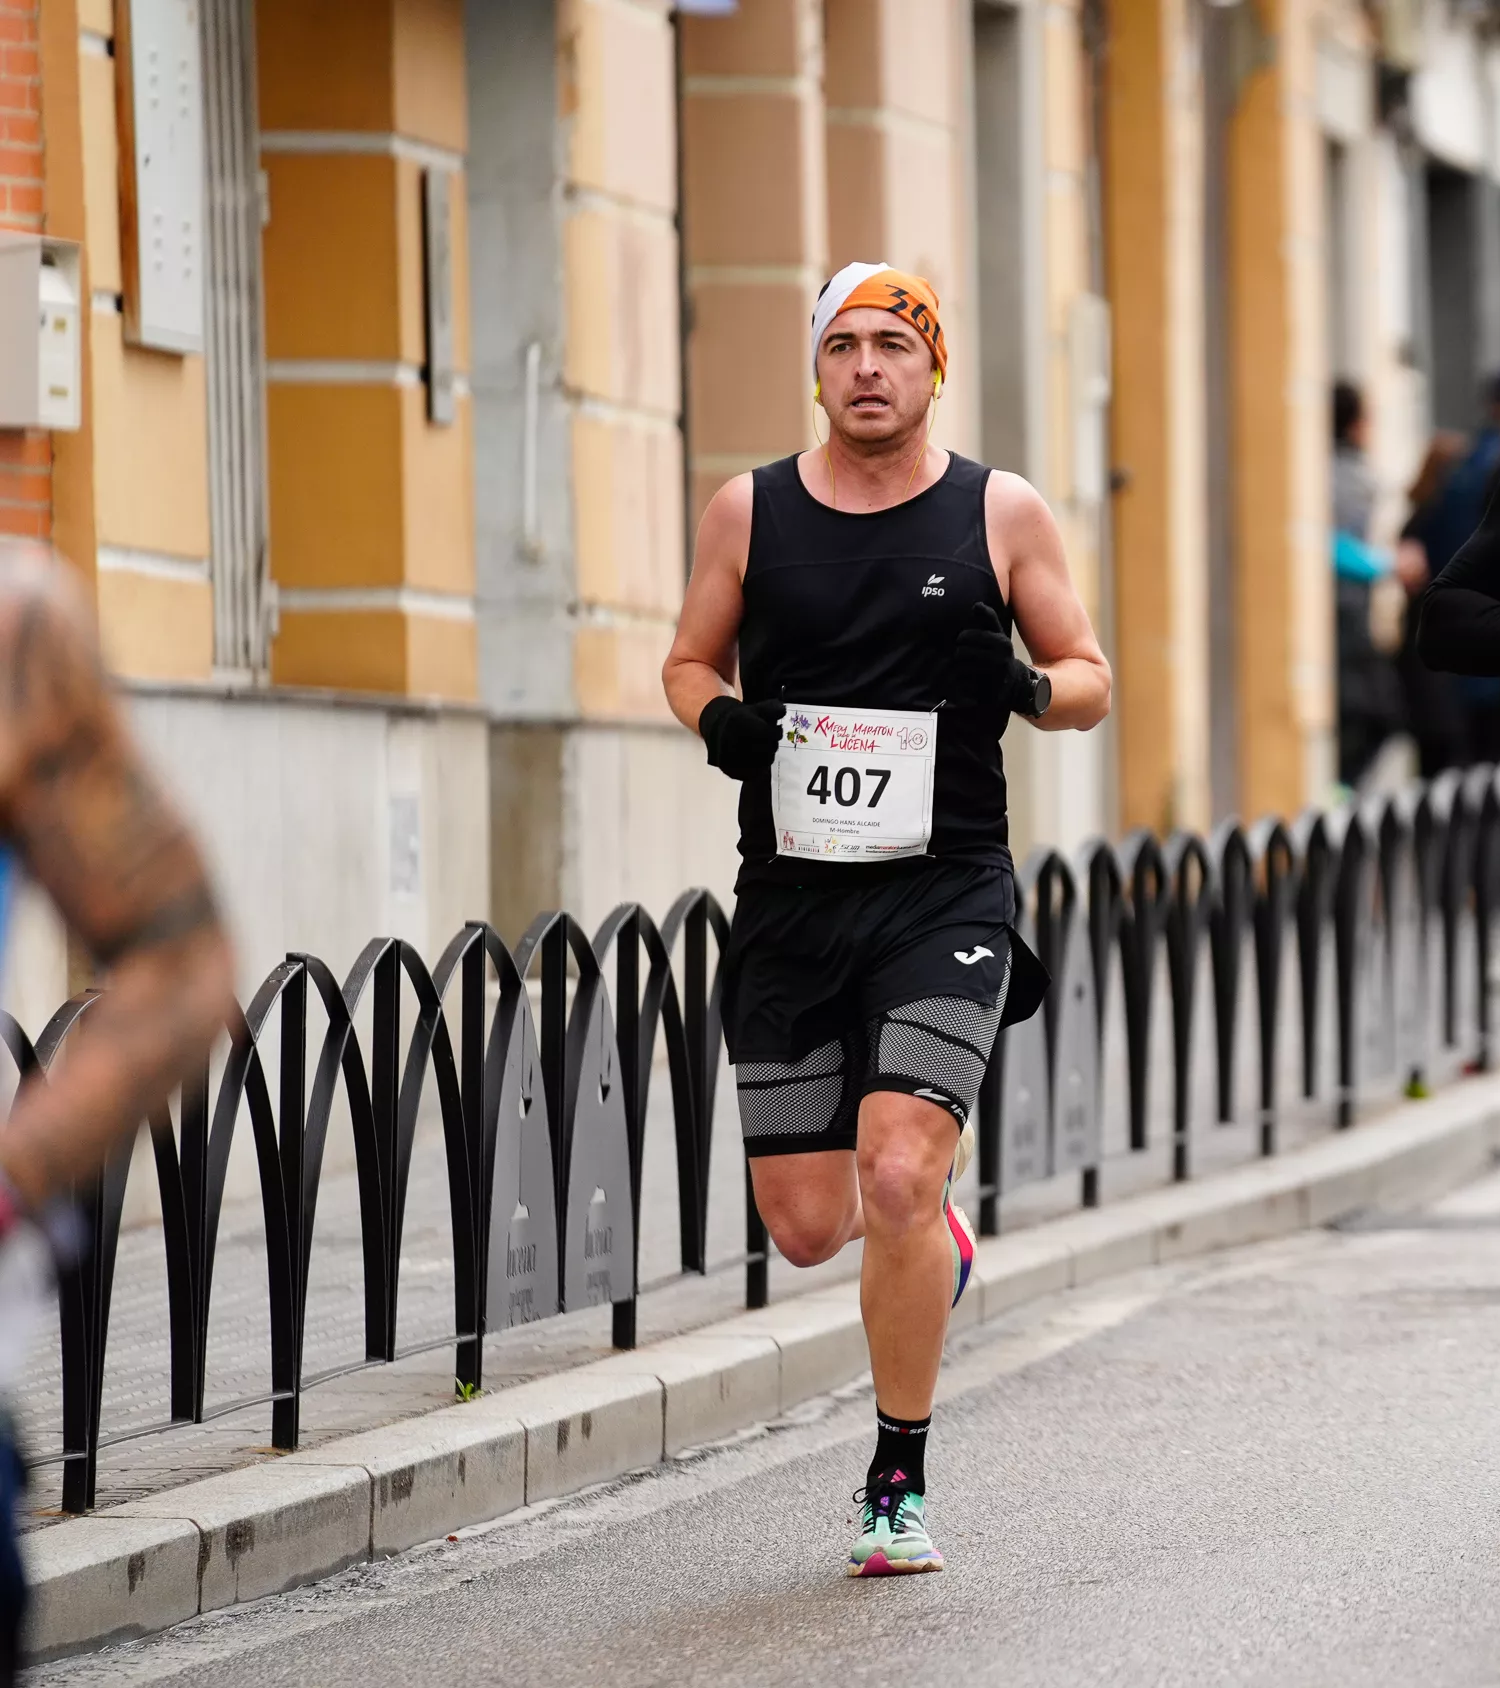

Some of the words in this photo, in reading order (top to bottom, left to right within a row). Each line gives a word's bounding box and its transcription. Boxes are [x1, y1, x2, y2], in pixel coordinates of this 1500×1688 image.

[830, 734, 881, 753] LUCENA
[806, 765, 891, 808] 407
[812, 817, 839, 826] DOMINGO
[839, 819, 856, 827] HANS
[857, 820, 881, 828] ALCAIDE
[829, 827, 860, 835] M-Hombre
